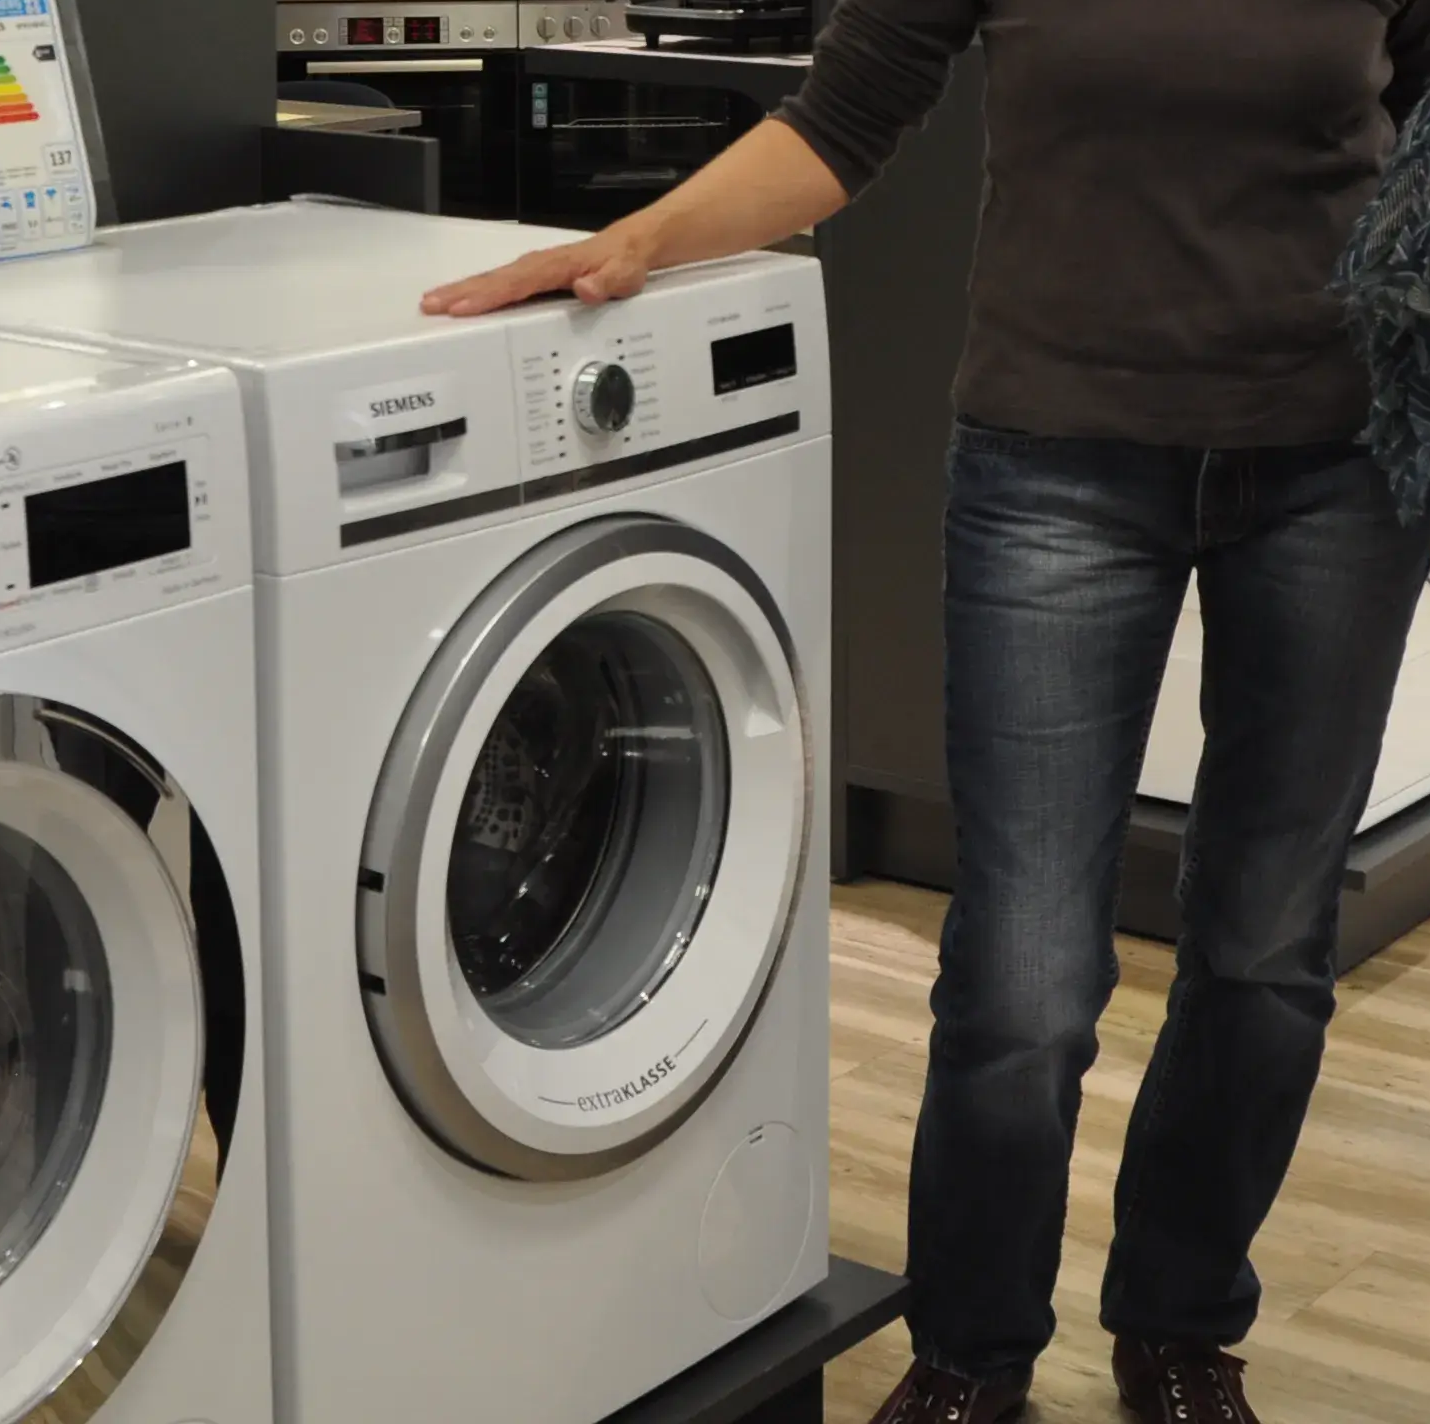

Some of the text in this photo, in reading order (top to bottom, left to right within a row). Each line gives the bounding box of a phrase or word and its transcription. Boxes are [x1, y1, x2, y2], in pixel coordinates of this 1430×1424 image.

[50, 150, 72, 166] 137
[370, 391, 436, 419] SIEMENS
[577, 1055, 677, 1112] extraKLASSE
